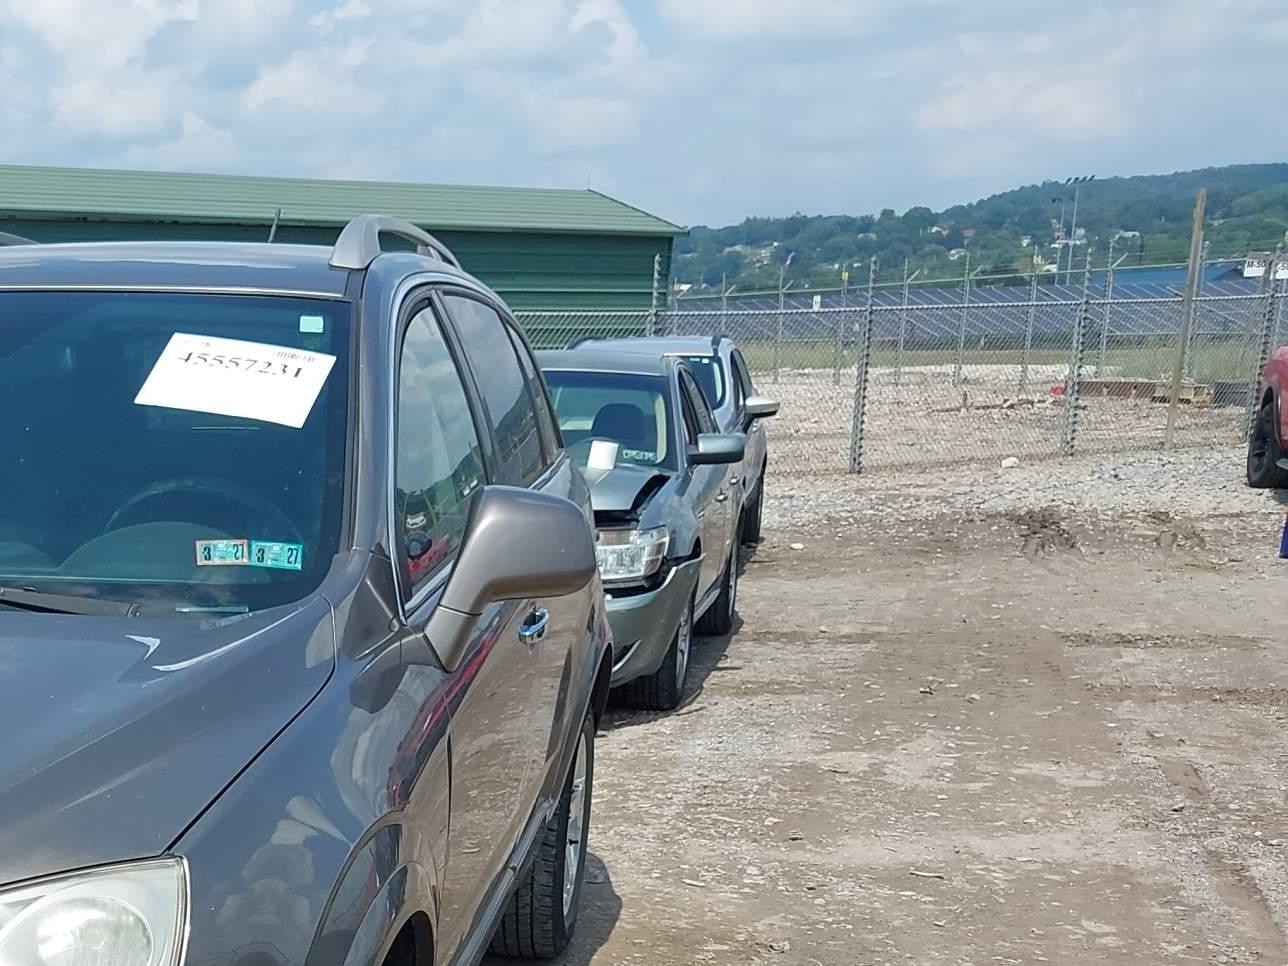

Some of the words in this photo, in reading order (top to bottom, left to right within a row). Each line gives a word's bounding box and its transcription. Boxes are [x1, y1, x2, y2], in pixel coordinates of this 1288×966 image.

[176, 350, 303, 378] 45557231
[232, 543, 245, 560] 27
[256, 548, 265, 562] 3
[287, 547, 299, 564] 27
